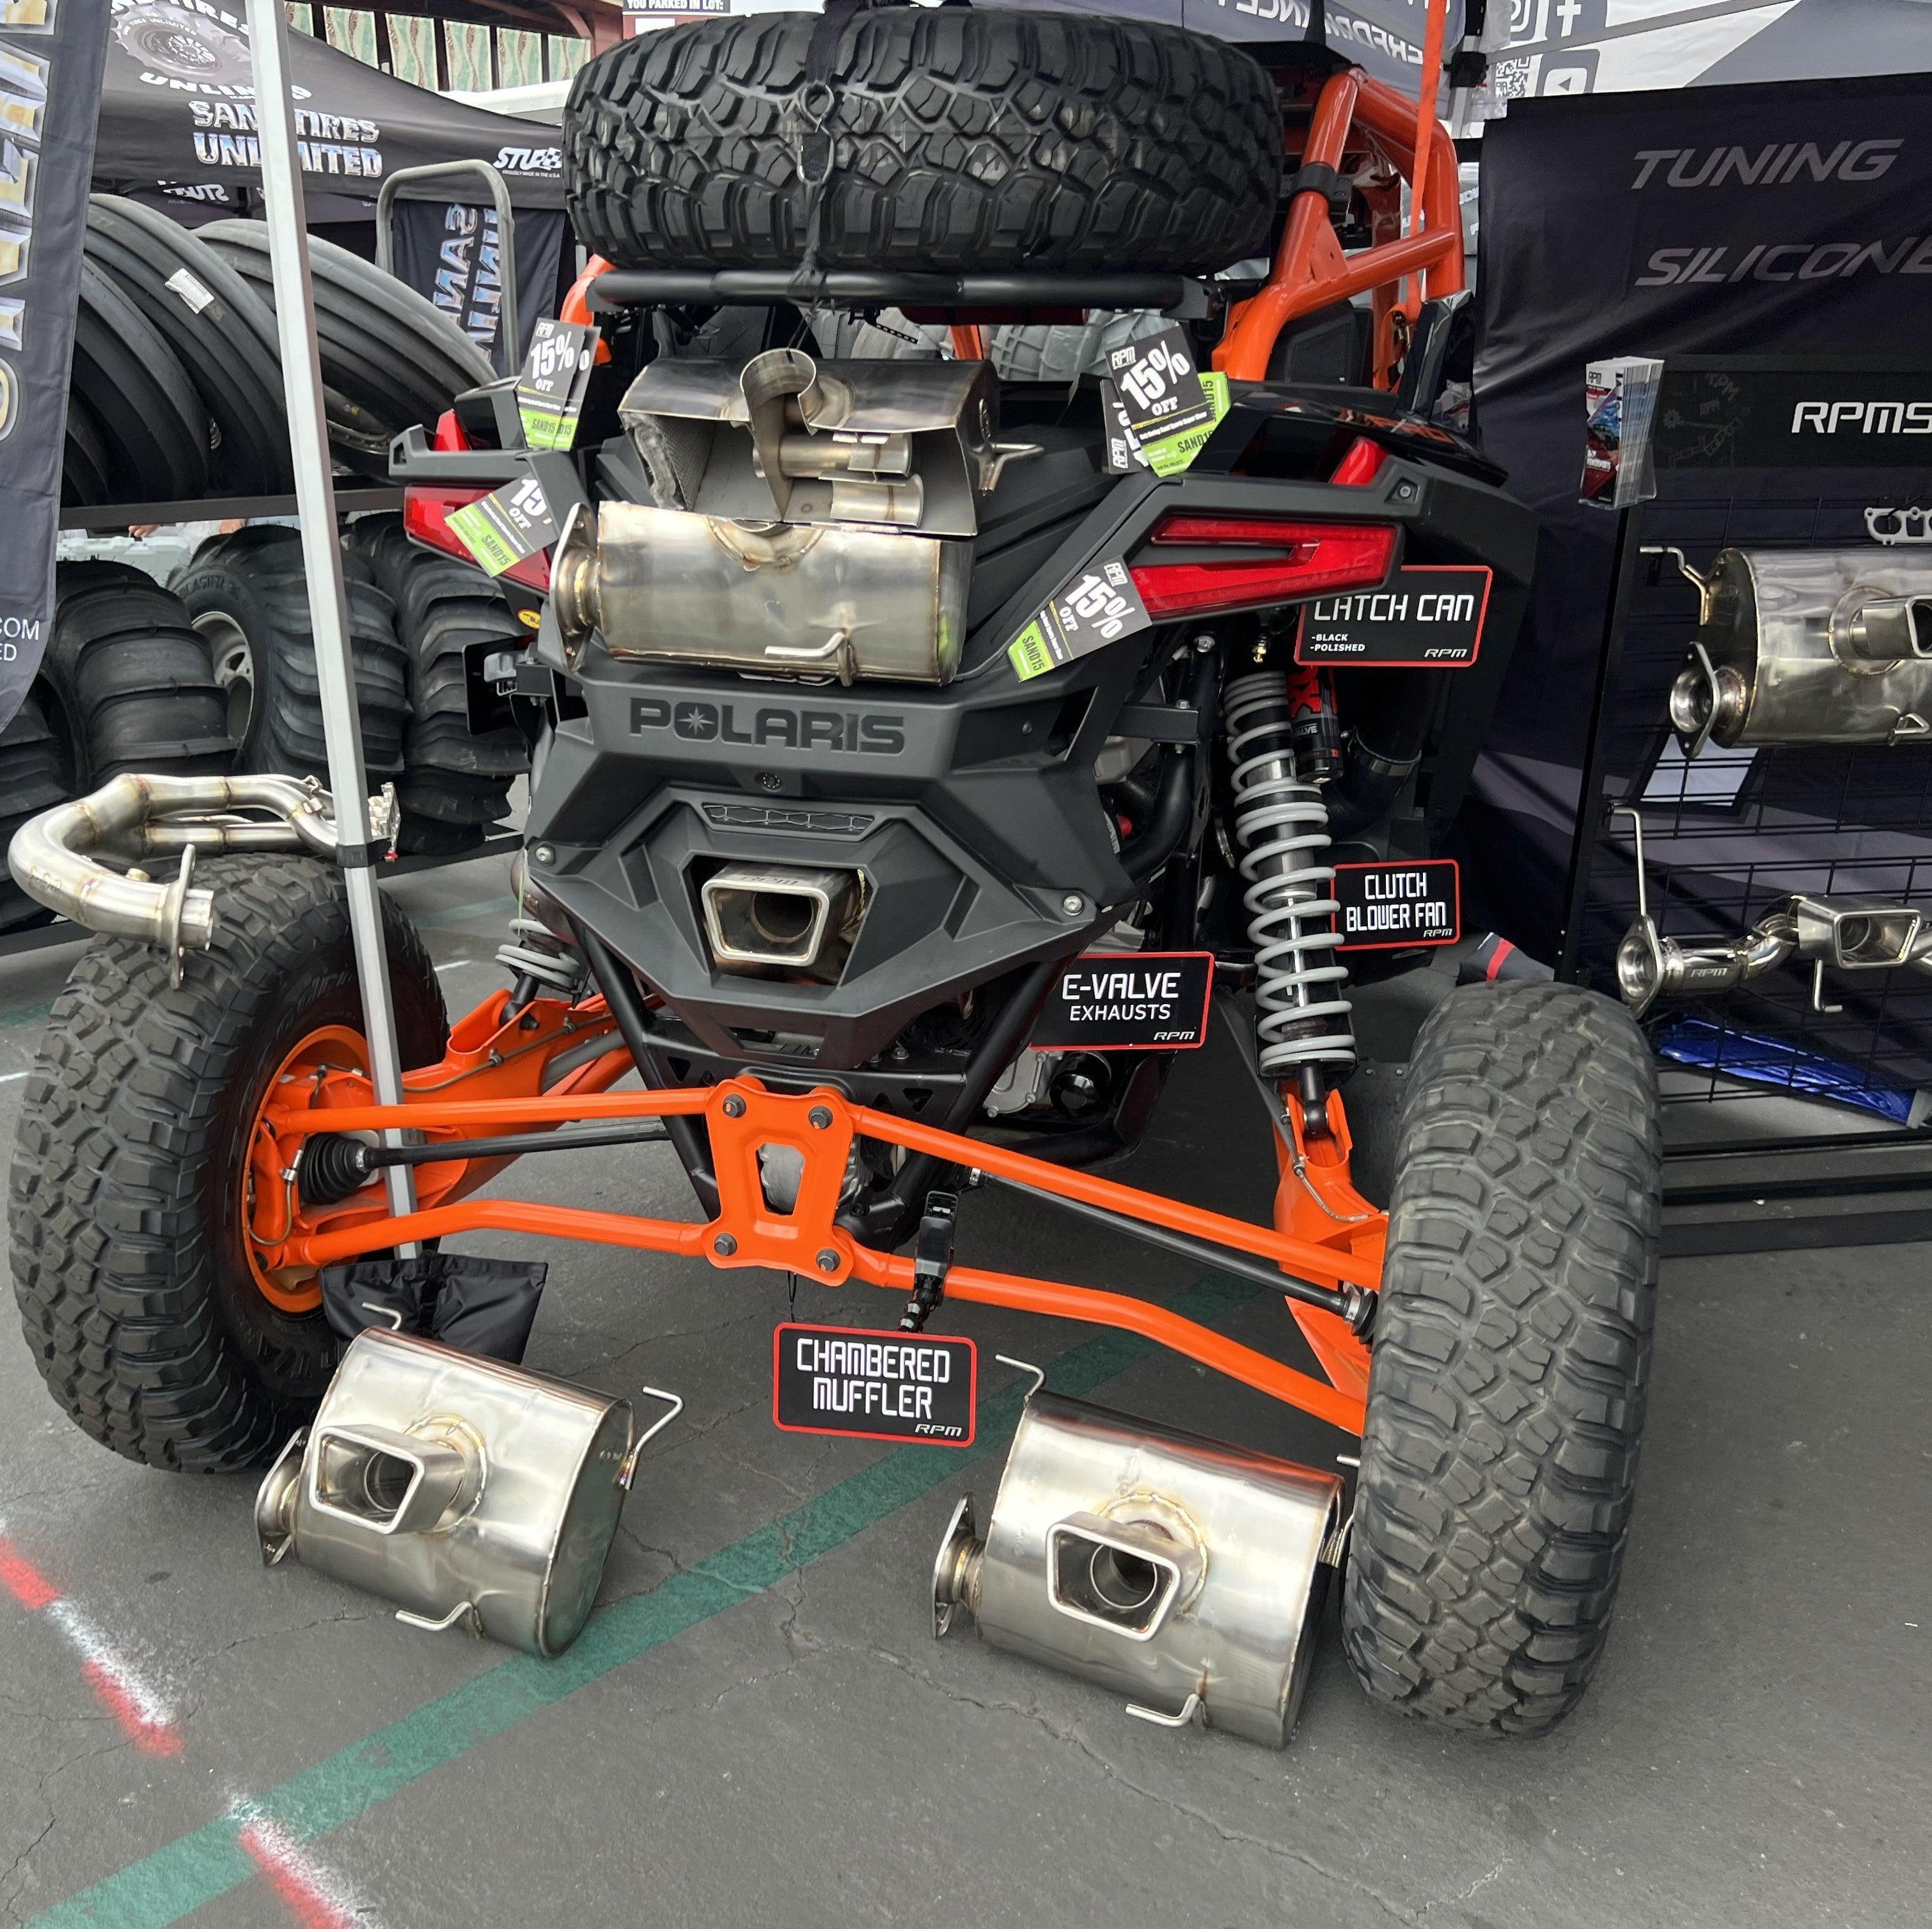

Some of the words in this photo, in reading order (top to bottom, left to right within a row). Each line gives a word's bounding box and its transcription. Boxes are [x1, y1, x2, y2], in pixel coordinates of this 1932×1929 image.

[648, 0, 687, 9] PARKED
[189, 100, 258, 130] SAN
[294, 109, 380, 143] TIRES
[1631, 139, 1905, 189] TUNING
[531, 331, 574, 379] 15%
[1111, 346, 1136, 368] RPM
[535, 379, 554, 391] OFF
[1120, 340, 1190, 410] 15%
[1152, 397, 1178, 416] OFF
[508, 506, 531, 529] OFF
[481, 535, 511, 566] SAND15
[1060, 606, 1079, 632] OFF
[1065, 574, 1135, 638] 15%
[1417, 594, 1474, 621] CAN
[1022, 635, 1045, 670] SAND15
[1424, 649, 1467, 657] RPM
[630, 698, 904, 755] POLARIS
[1365, 872, 1427, 900] CLUTCH
[1346, 904, 1410, 932] BLOWER
[1415, 902, 1446, 927] FAN
[1424, 929, 1452, 938] RPM
[1062, 973, 1181, 1000] E-VALVE
[1070, 1004, 1171, 1021] EXHAUSTS
[1154, 1031, 1195, 1041] RPM
[797, 1338, 950, 1383] CHAMBERED
[813, 1377, 932, 1419] MUFFLER
[915, 1424, 962, 1437] RPM
